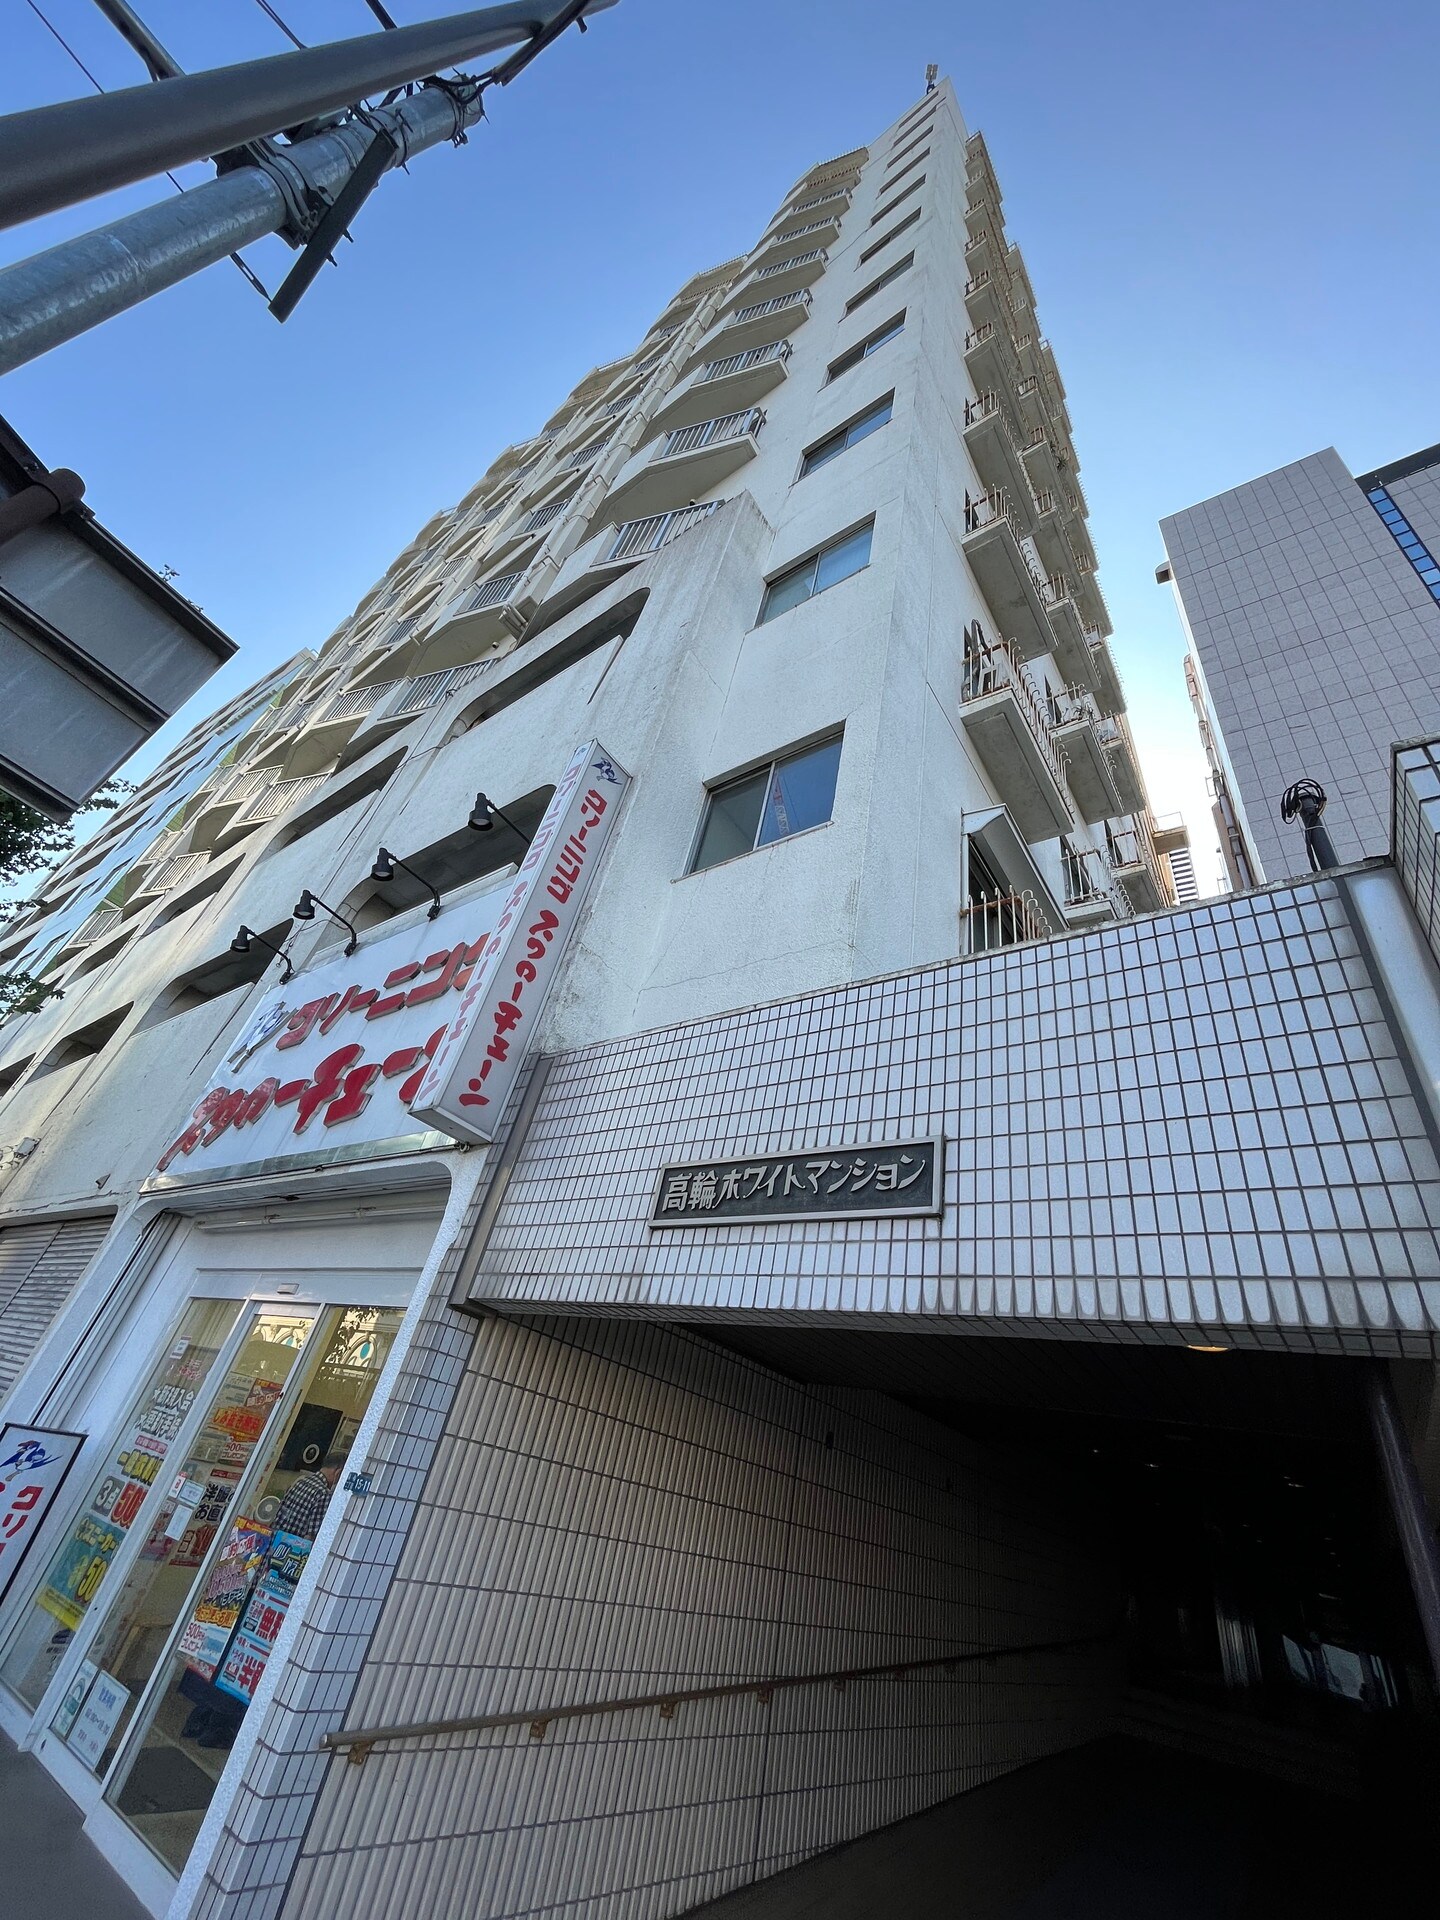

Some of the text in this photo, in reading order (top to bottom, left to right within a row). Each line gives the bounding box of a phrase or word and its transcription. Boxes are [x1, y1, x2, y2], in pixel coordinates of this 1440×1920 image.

[459, 788, 608, 1106] クリーニング スワローチェーン
[661, 1153, 926, 1213] 高輪ホワイトマンション
